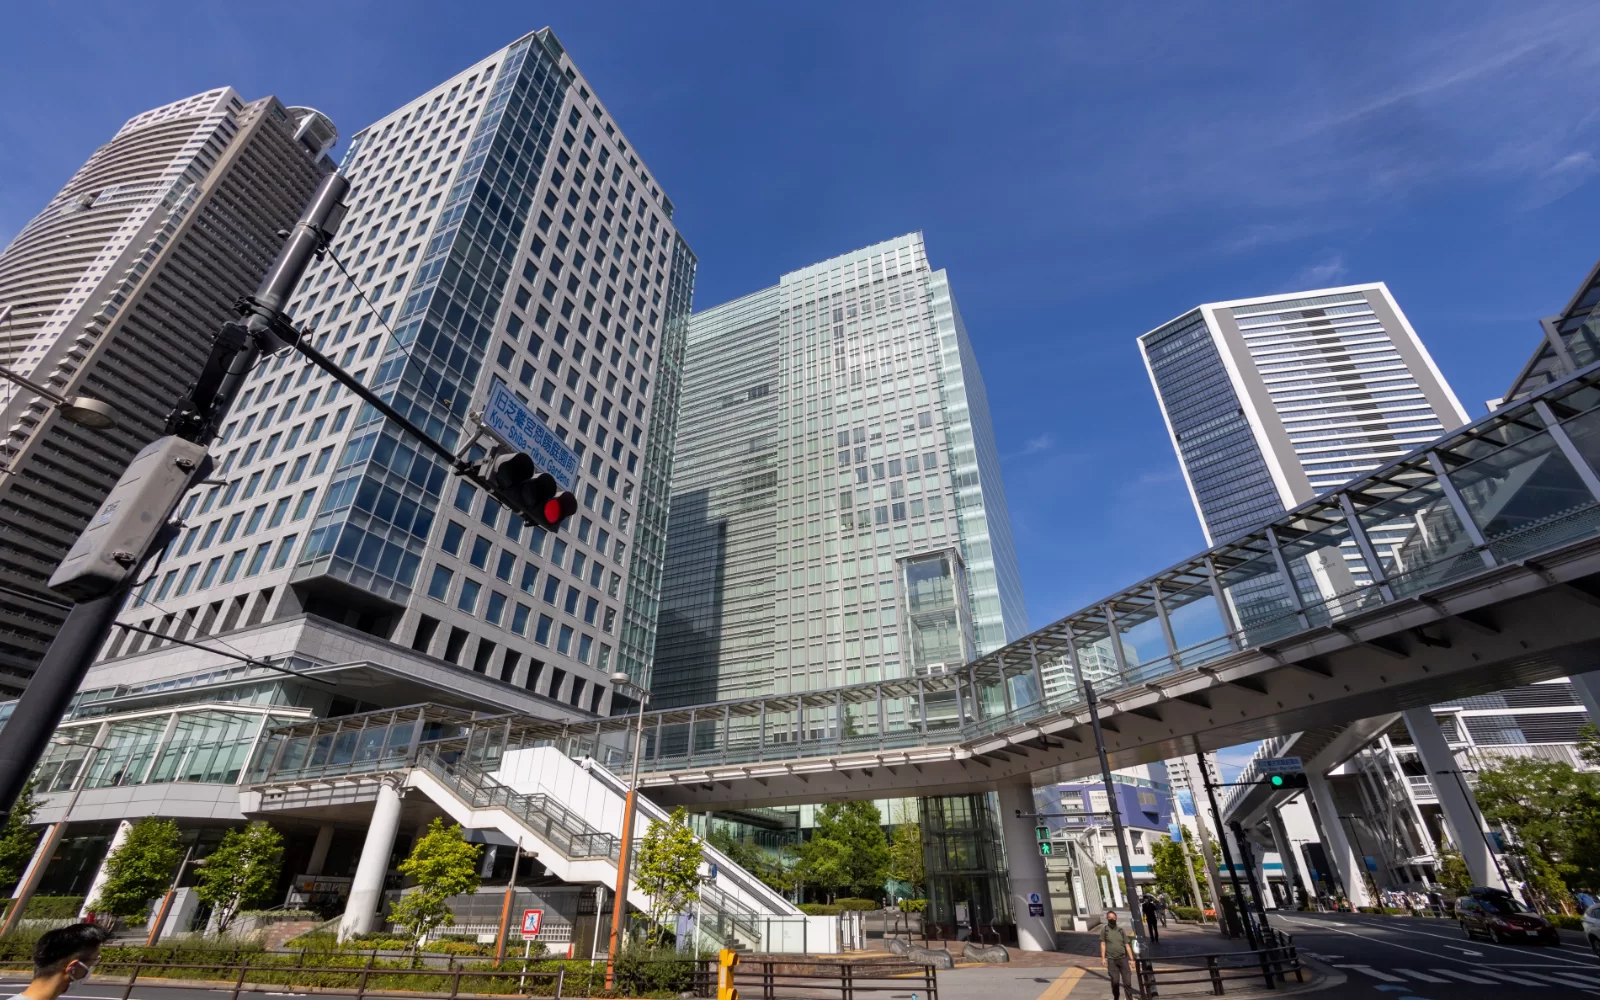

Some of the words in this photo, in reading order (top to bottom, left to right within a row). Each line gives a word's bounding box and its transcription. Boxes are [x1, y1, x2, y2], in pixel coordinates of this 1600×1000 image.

[495, 389, 576, 474] 旧芝離宮恩賜庭園前
[547, 459, 570, 487] Gardens
